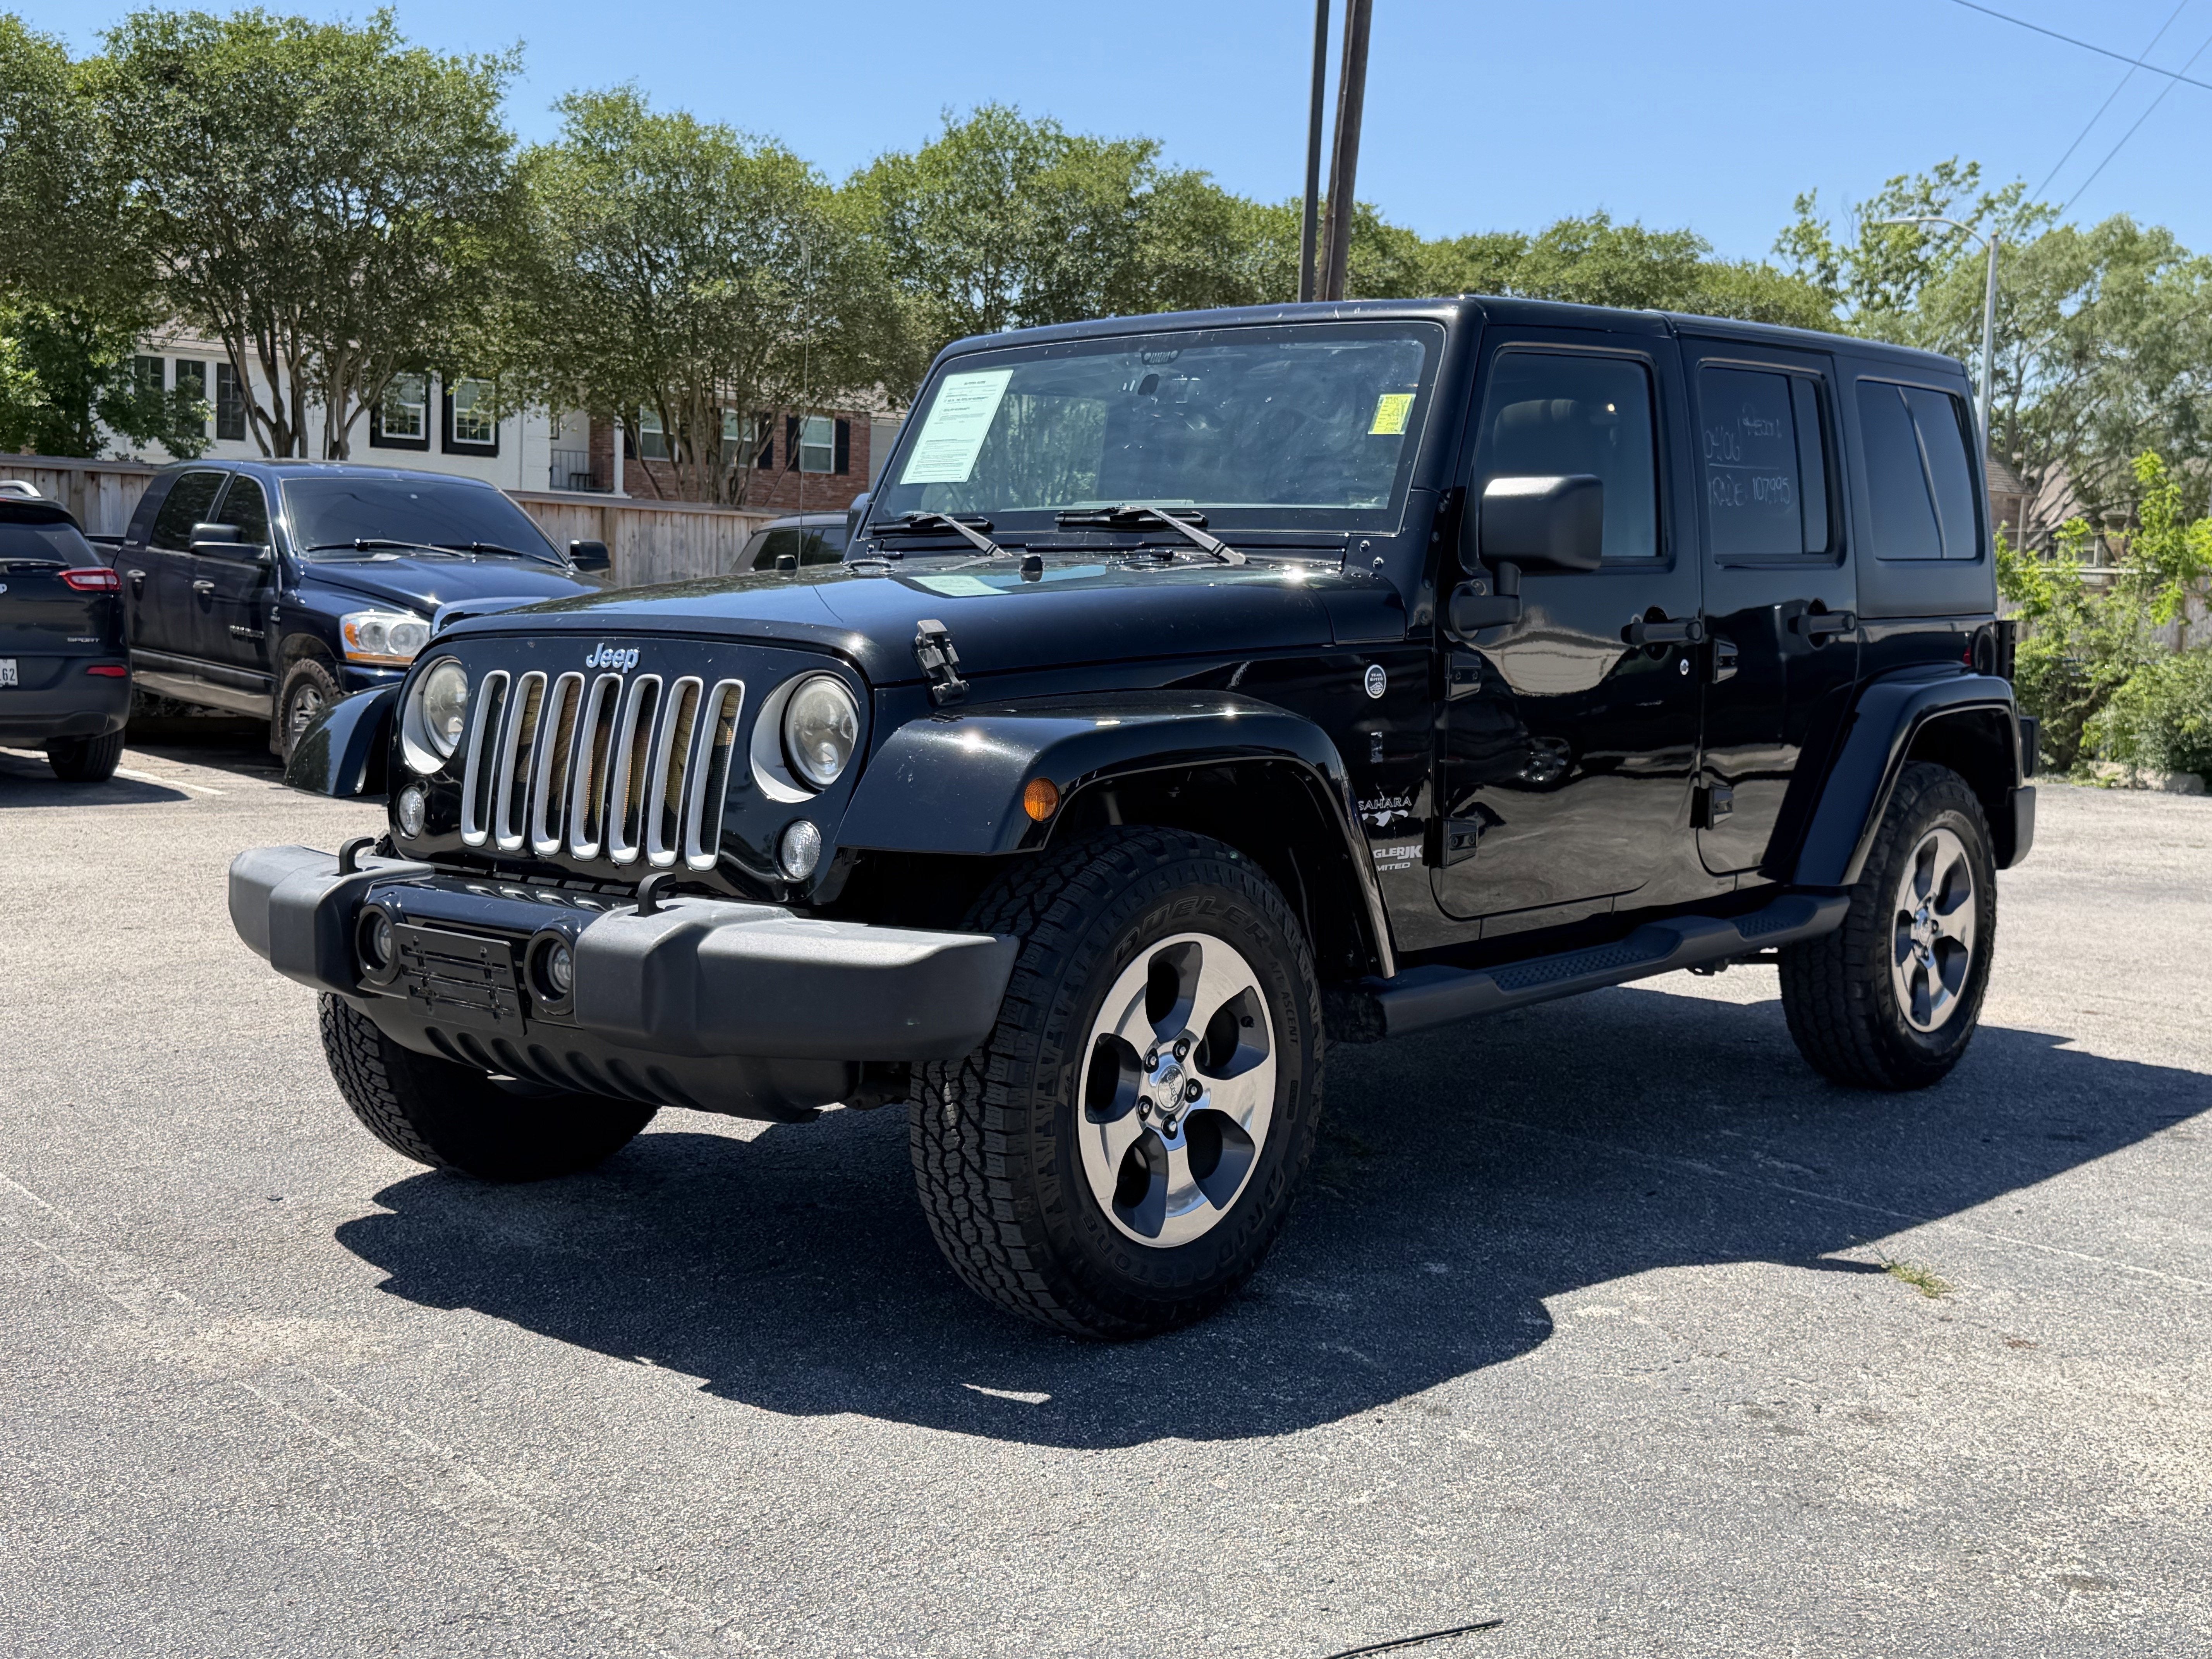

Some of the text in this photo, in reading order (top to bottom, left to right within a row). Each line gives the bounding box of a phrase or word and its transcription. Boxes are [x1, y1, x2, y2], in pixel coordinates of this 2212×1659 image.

[586, 642, 639, 673] Jeep
[0, 668, 15, 681] 62
[1357, 796, 1412, 811] SAHARA
[1114, 895, 1272, 969] DUELER
[1281, 991, 1298, 1046] ASCENT
